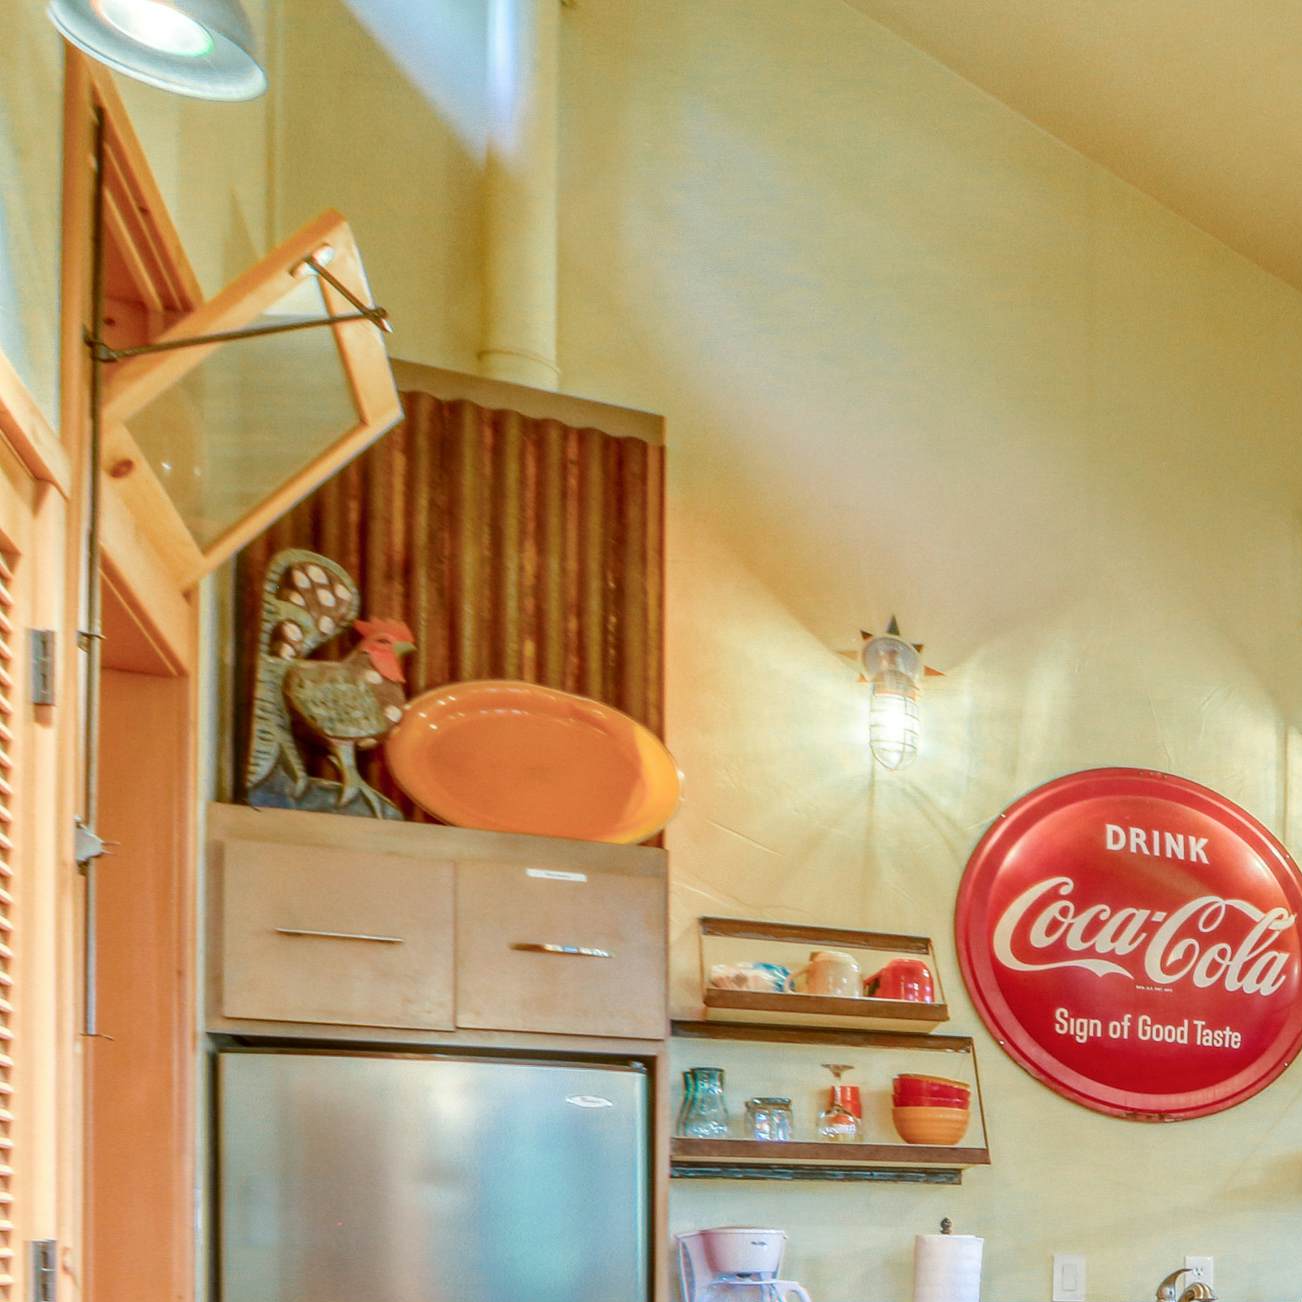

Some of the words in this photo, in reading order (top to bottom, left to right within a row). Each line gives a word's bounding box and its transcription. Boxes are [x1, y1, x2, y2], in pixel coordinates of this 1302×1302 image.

[1105, 823, 1210, 865] DRINK
[993, 876, 1297, 997] Coca-Cola
[1054, 1007, 1102, 1044] Sign
[1108, 1014, 1132, 1040] of
[1138, 1014, 1189, 1045] Good
[1194, 1020, 1242, 1050] Taste
